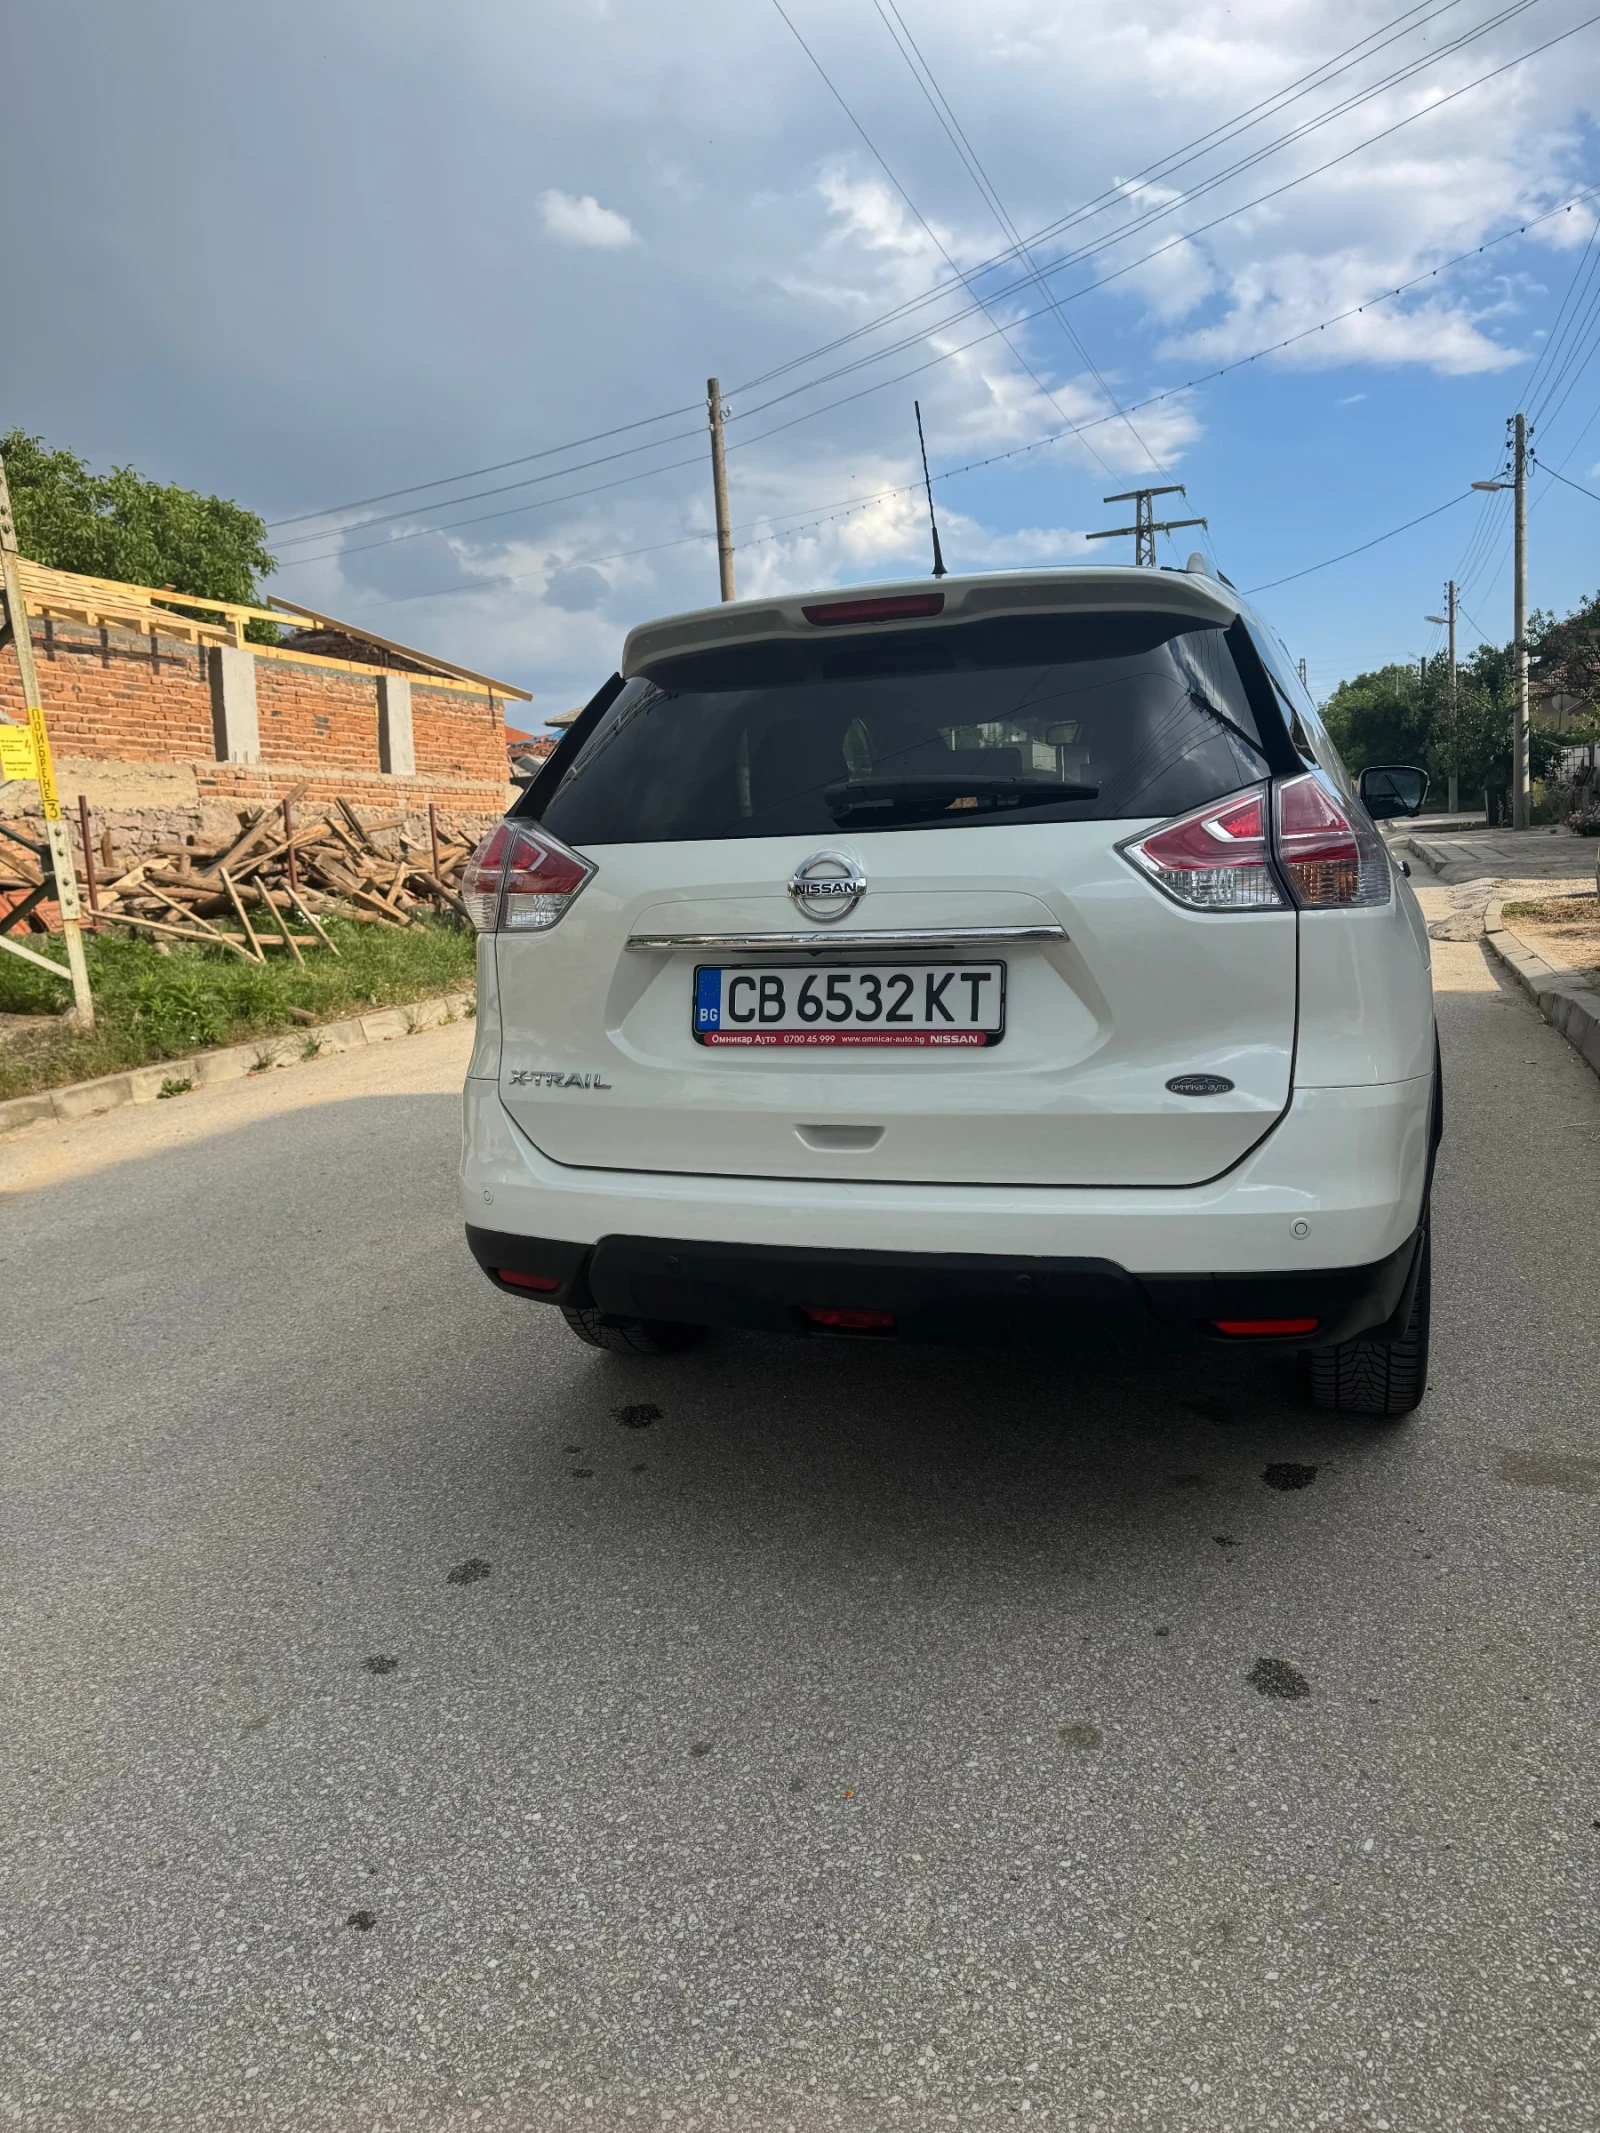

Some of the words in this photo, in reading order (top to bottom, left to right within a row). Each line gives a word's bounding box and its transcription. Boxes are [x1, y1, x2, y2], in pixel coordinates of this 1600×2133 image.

[47, 803, 58, 818] 3
[795, 882, 857, 895] NISSAN
[728, 975, 786, 1023] CB
[797, 974, 914, 1023] 6532
[925, 972, 992, 1022] KT
[699, 1008, 718, 1022] BG
[711, 1034, 753, 1045] Омникар
[755, 1034, 777, 1045] Ауто
[783, 1035, 805, 1043] 0700
[806, 1035, 818, 1043] 45
[819, 1035, 836, 1043] 999
[841, 1034, 925, 1045] www.omnicar-auto.bg
[930, 1035, 978, 1043] NISSAN
[508, 1070, 612, 1090] X-TRAIL
